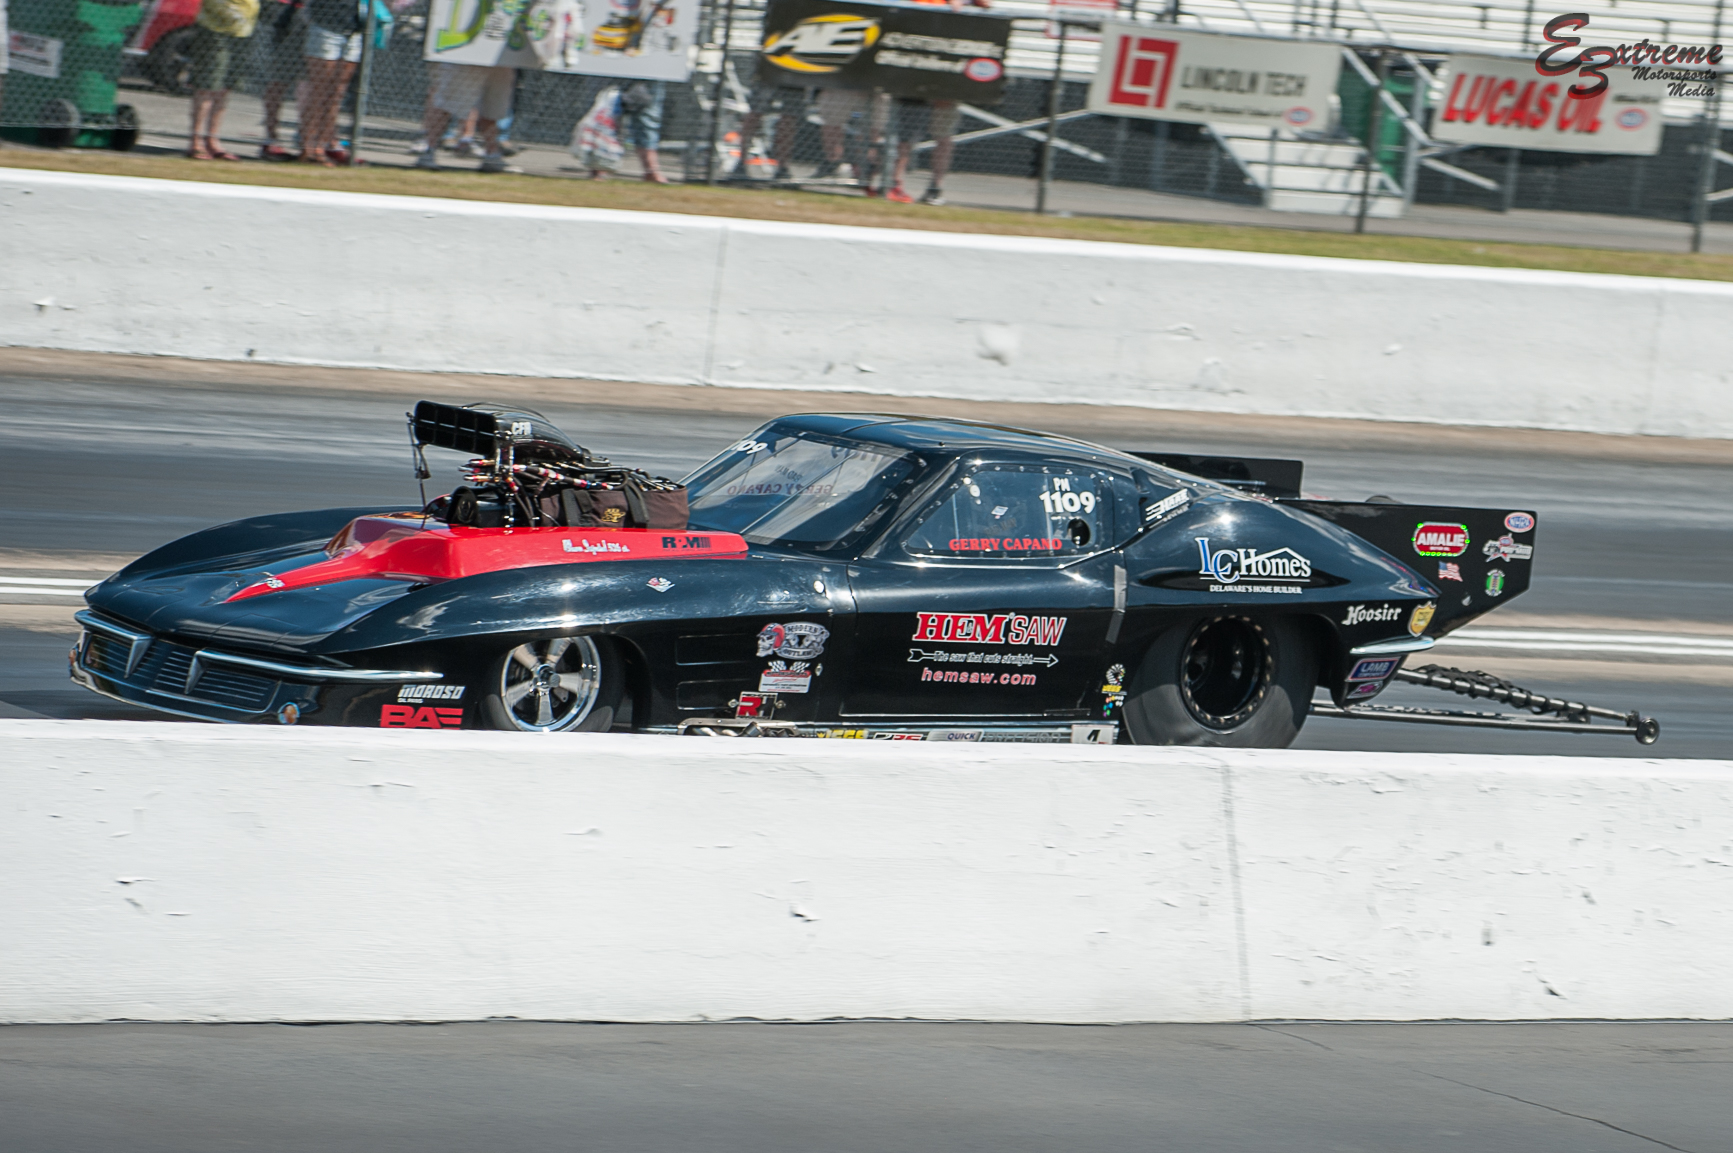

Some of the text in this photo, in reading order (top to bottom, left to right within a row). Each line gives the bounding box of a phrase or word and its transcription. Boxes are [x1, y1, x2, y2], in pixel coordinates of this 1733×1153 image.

[1181, 66, 1308, 97] LINCOLN TECH
[1442, 73, 1562, 130] LUCAS
[1556, 84, 1611, 133] OIL
[1053, 477, 1070, 491] PM
[1039, 491, 1095, 513] 1109
[949, 538, 1062, 551] GERRY CAPANO
[1416, 532, 1466, 547] AMALIE
[1195, 537, 1311, 583] LC Homes
[1209, 584, 1303, 594] DELAWARE'S HOME BUILDER
[1341, 603, 1402, 625] Hoosier
[1008, 615, 1067, 646] SAW
[933, 651, 948, 662] The
[949, 653, 966, 662] saw
[966, 652, 982, 663] that
[983, 653, 1000, 664] cuts
[921, 667, 1037, 685] hemsaw.com
[1360, 662, 1391, 673] LAMB
[379, 704, 464, 730] BAE
[947, 732, 976, 741] QUICK
